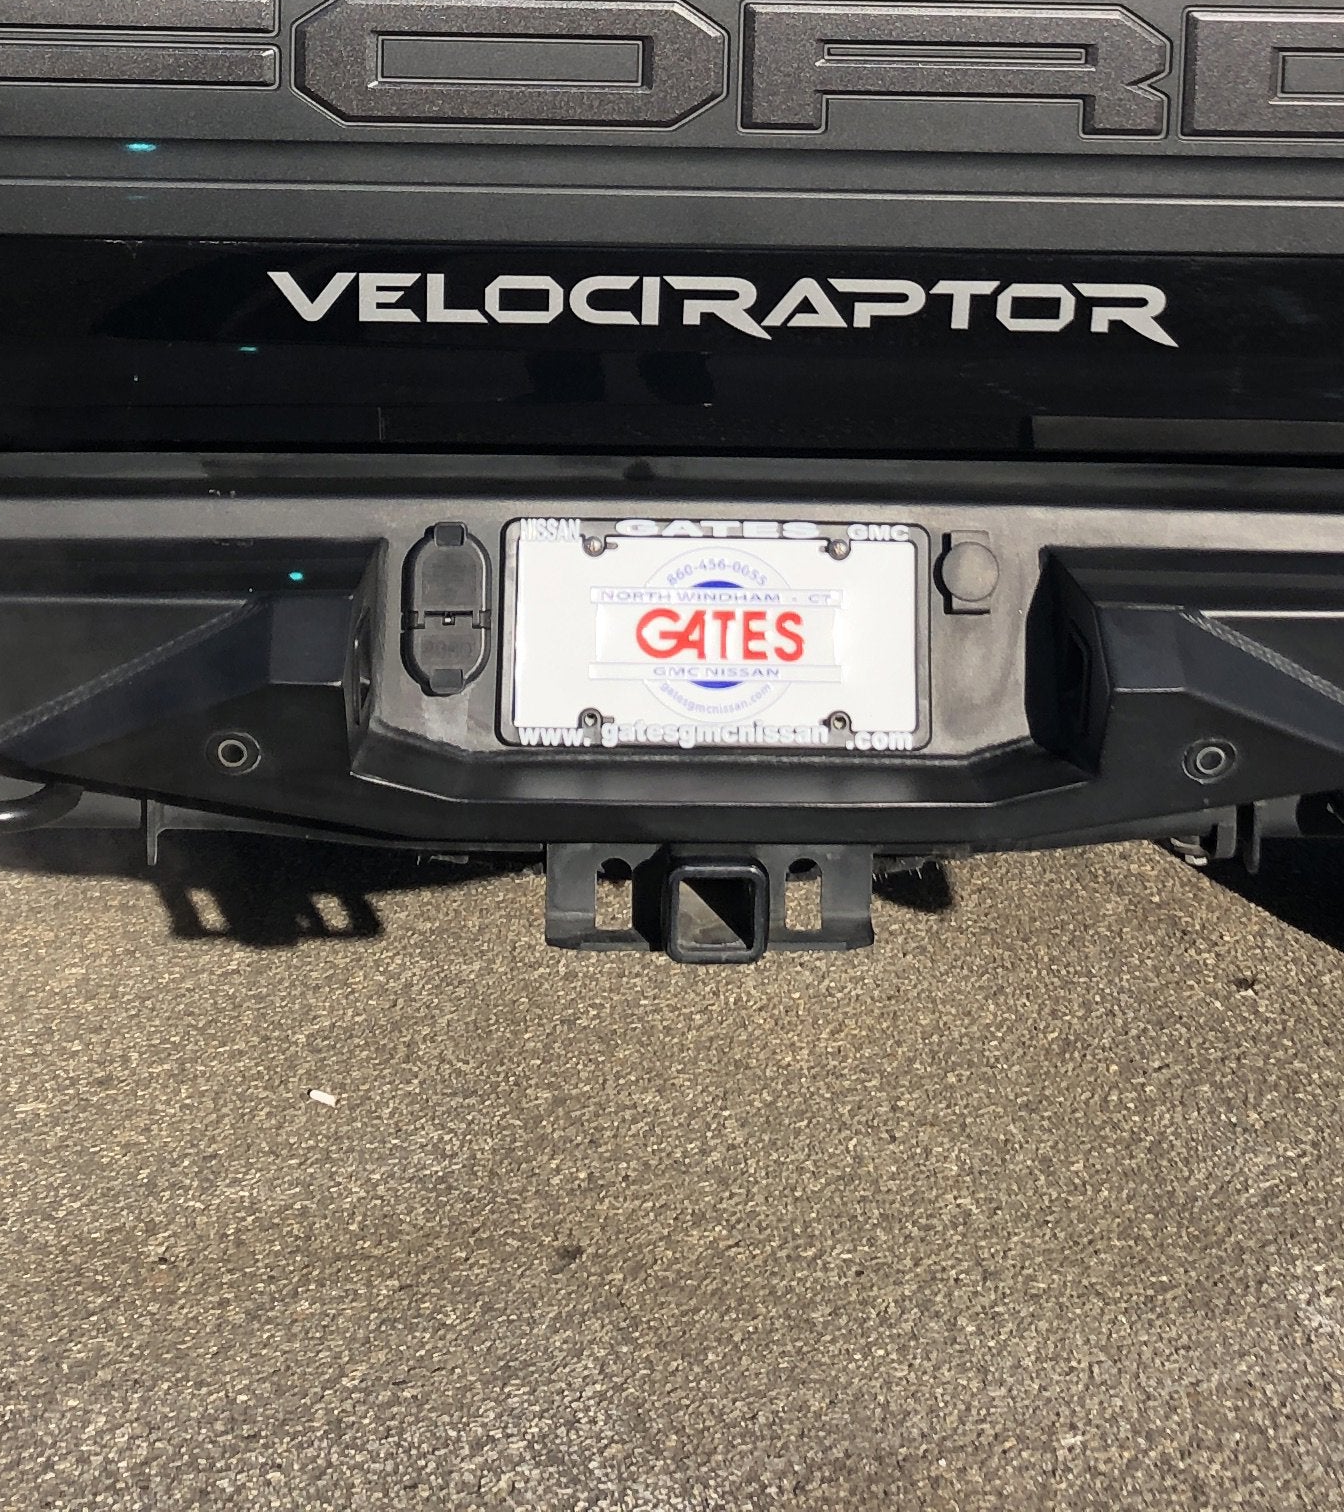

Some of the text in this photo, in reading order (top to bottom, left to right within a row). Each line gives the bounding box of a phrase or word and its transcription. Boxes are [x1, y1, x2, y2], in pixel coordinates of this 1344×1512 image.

[267, 271, 1180, 348] VELOCIRAPTOR
[520, 518, 910, 542] NISSAN GATES GMC
[666, 558, 768, 586] 860-456-0055
[600, 590, 832, 603] NORTH WINDHAM CT
[636, 608, 805, 662] GATES
[653, 666, 780, 678] GMC NISSAN
[659, 683, 772, 714] gatesgmcnissan.com
[601, 719, 829, 748] gatesgmcnissan
